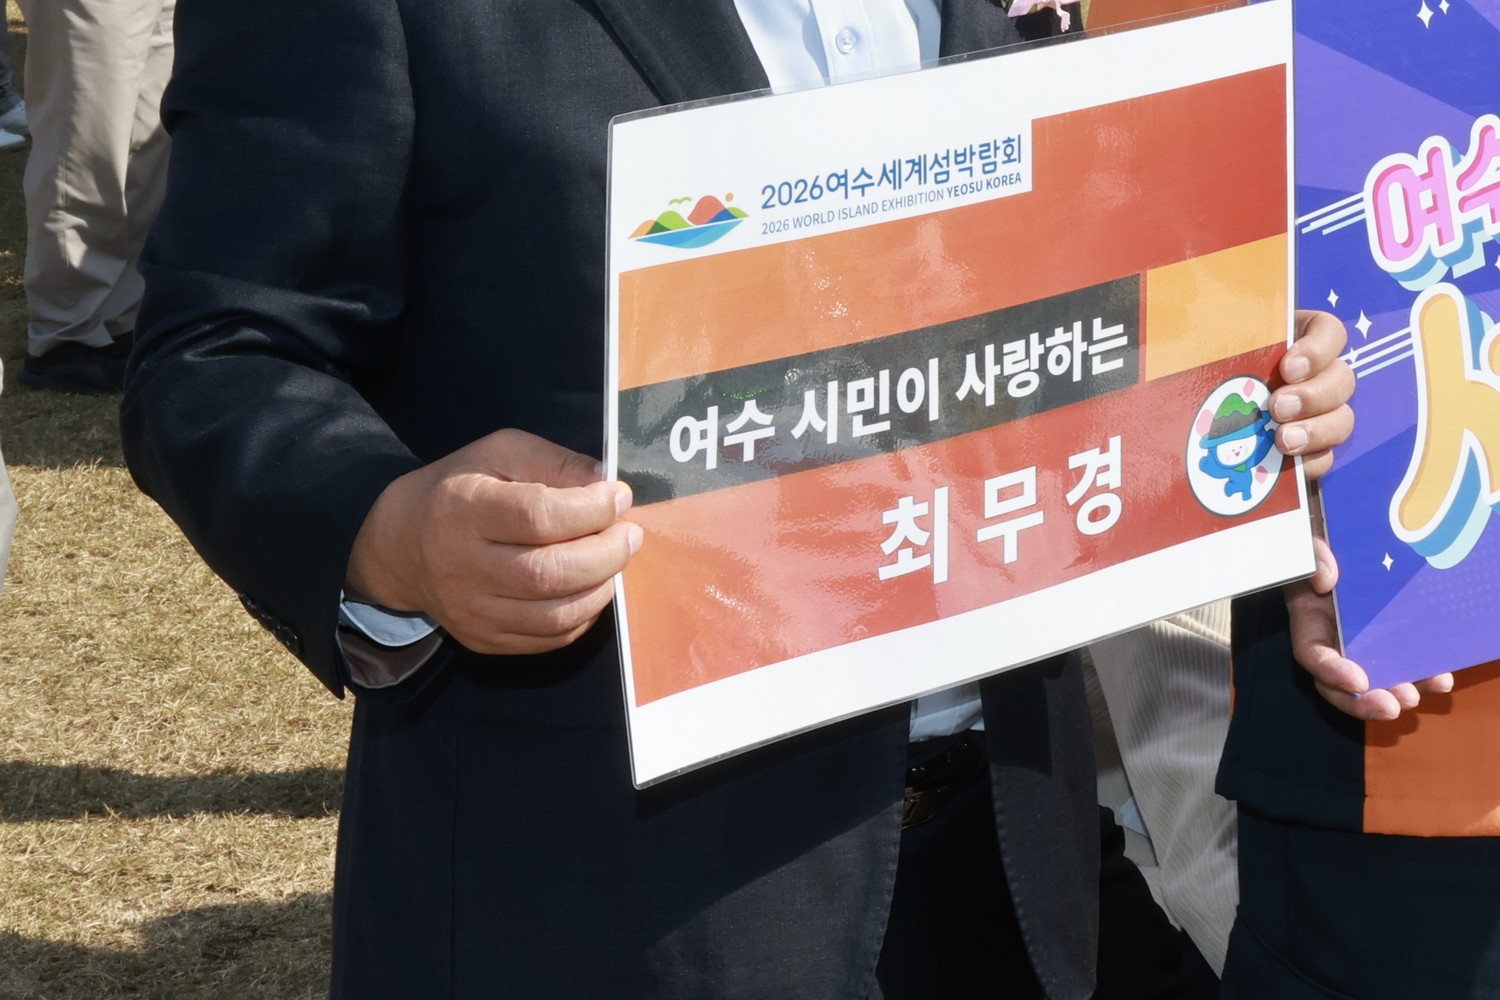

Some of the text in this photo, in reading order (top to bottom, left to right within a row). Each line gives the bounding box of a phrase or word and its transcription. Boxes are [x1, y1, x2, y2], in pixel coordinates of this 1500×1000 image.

[761, 134, 1021, 210] 2026여수세계섬박람회
[762, 172, 1022, 235] 2026 WORLD ISLAND EXHIBITION YEOSU KOREA
[669, 317, 1128, 470] 여수 시민이 사랑하는
